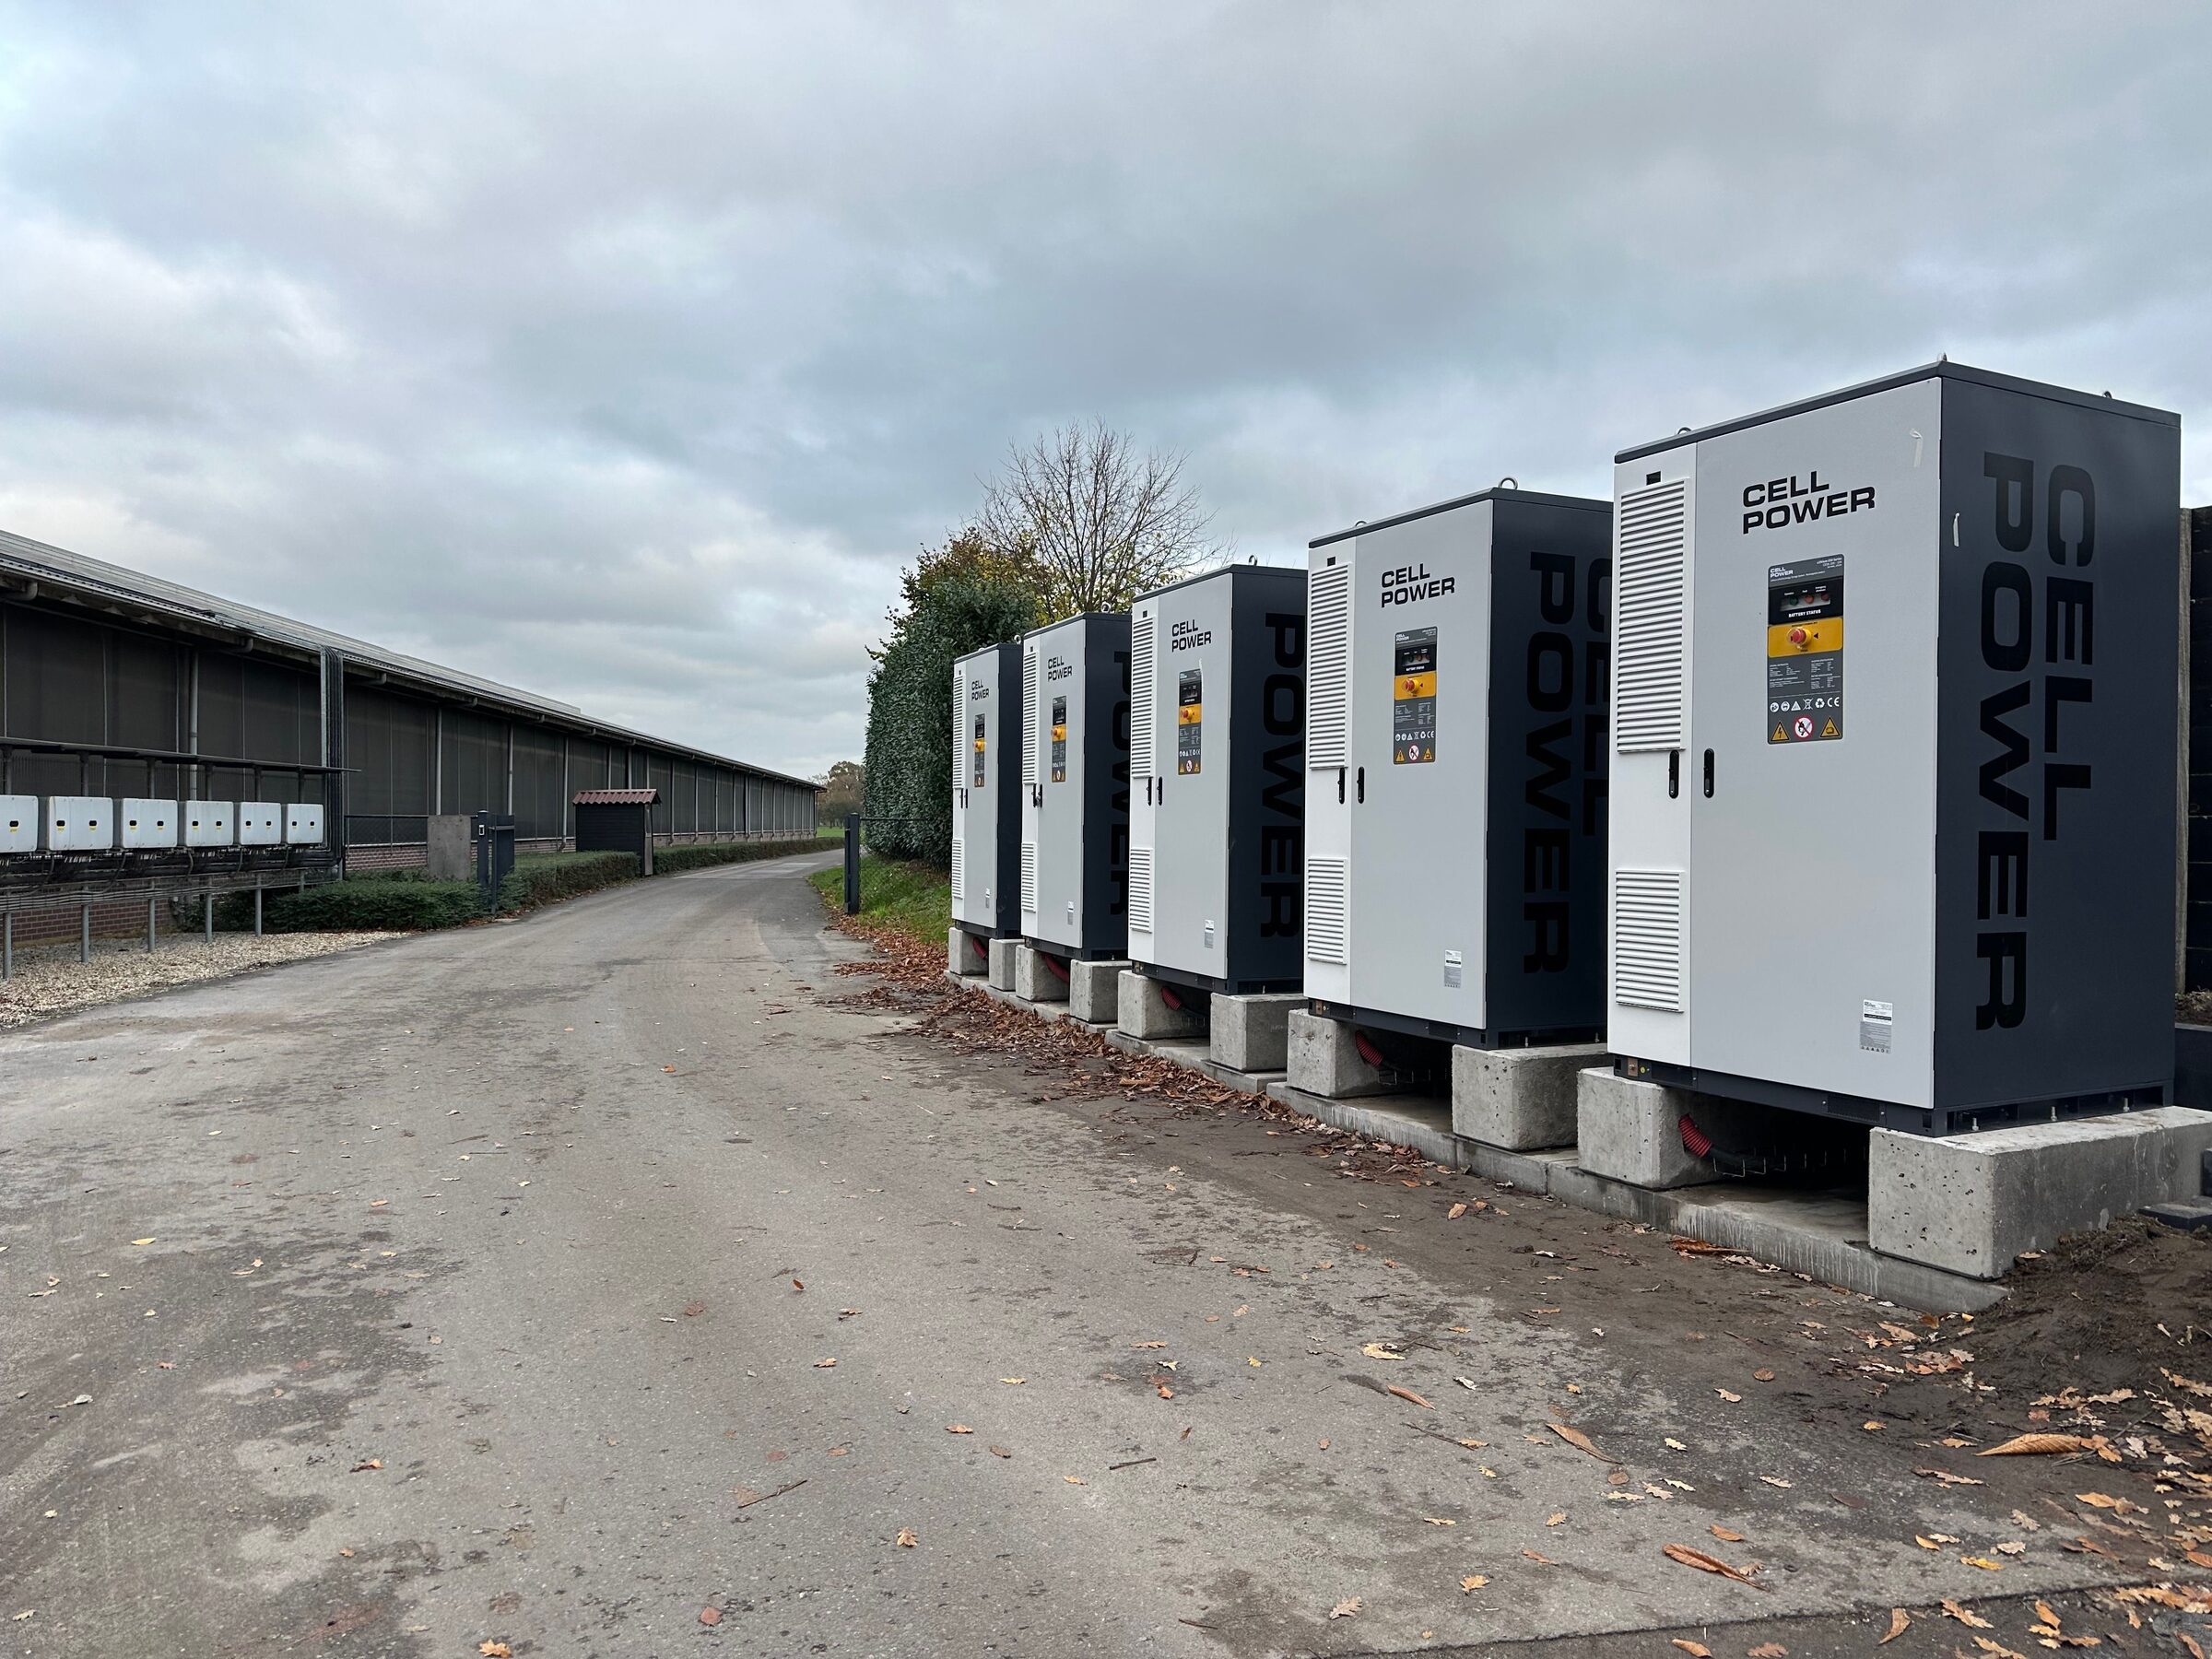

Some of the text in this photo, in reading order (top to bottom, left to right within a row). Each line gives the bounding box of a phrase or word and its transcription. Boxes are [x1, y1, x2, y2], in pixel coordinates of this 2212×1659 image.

[1743, 471, 1830, 507] CELL
[1743, 487, 1876, 535] POWER
[1382, 563, 1430, 588] CELL
[1770, 570, 1794, 579] POWER
[1382, 577, 1455, 608] POWER
[1171, 619, 1199, 637] CELL
[1171, 630, 1211, 653] POWER
[1047, 655, 1065, 670] CELL
[2042, 465, 2096, 841] CELL
[1047, 665, 1073, 682] POWER
[971, 688, 990, 700] POWER
[1976, 450, 2034, 1030] POWER
[1261, 612, 1306, 938] POWER
[1524, 551, 1576, 974] POWER
